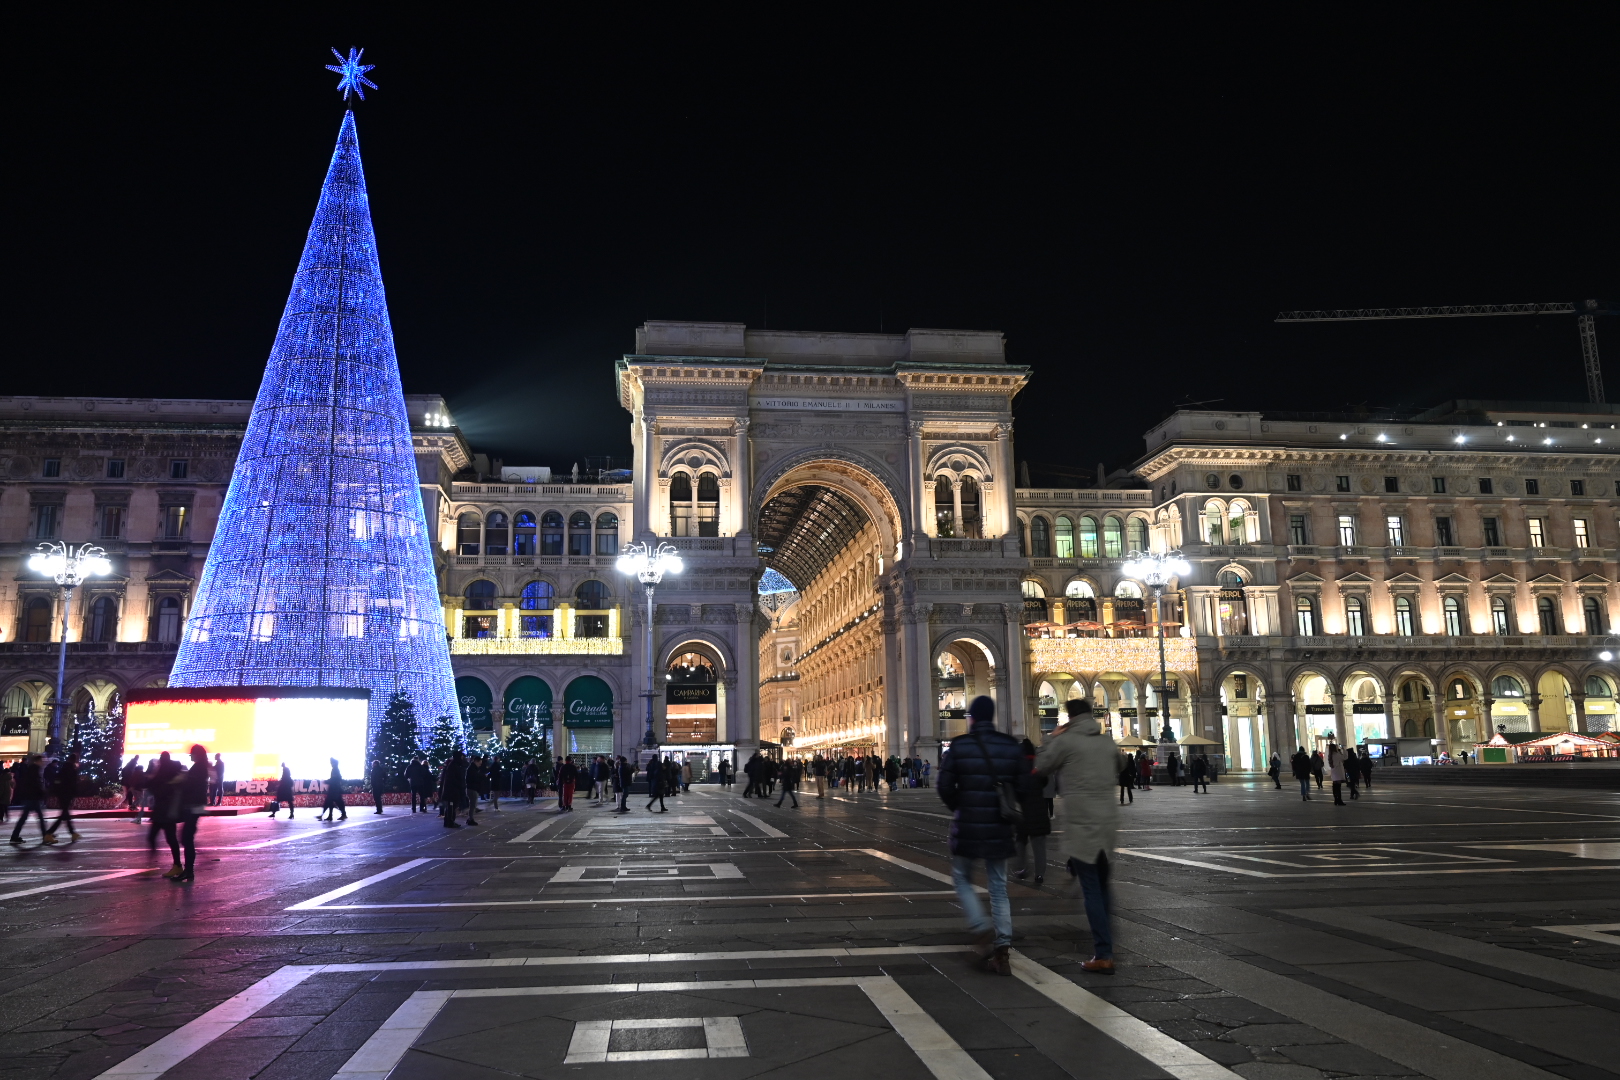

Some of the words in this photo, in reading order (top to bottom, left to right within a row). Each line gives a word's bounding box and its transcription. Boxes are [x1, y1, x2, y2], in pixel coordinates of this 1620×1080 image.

[1023, 600, 1042, 608] PEROL
[1066, 599, 1091, 608] APEROL
[1115, 599, 1140, 608] APEROL
[673, 688, 710, 697] CAMPARINO
[569, 699, 608, 715] Currado
[235, 780, 269, 794] PER
